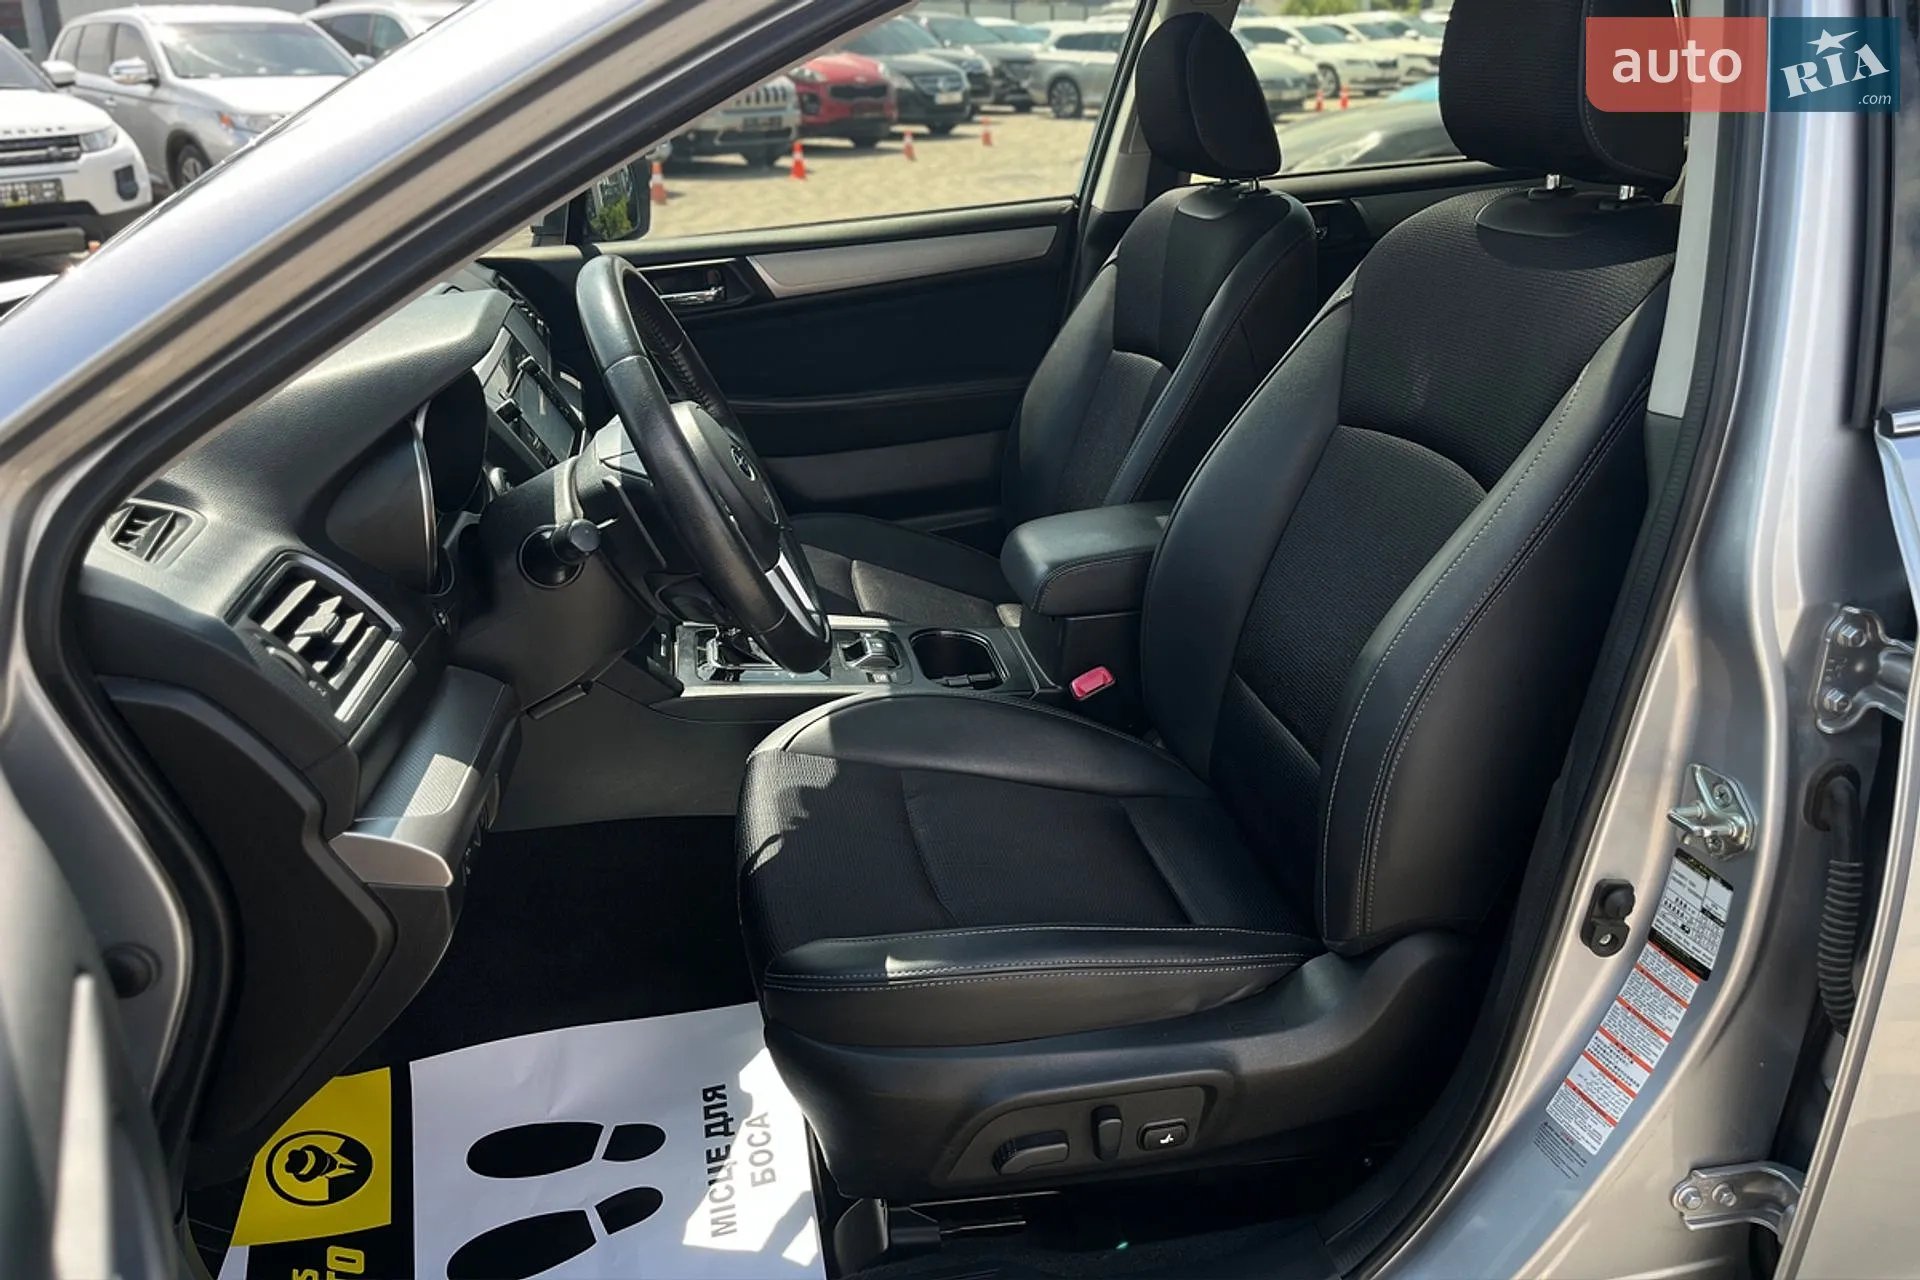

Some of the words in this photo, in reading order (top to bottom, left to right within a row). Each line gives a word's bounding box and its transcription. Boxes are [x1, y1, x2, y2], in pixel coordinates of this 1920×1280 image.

[702, 1083, 735, 1139] ДЛЯ
[745, 1112, 776, 1187] БОСА
[706, 1144, 737, 1238] МІСЦЕ
